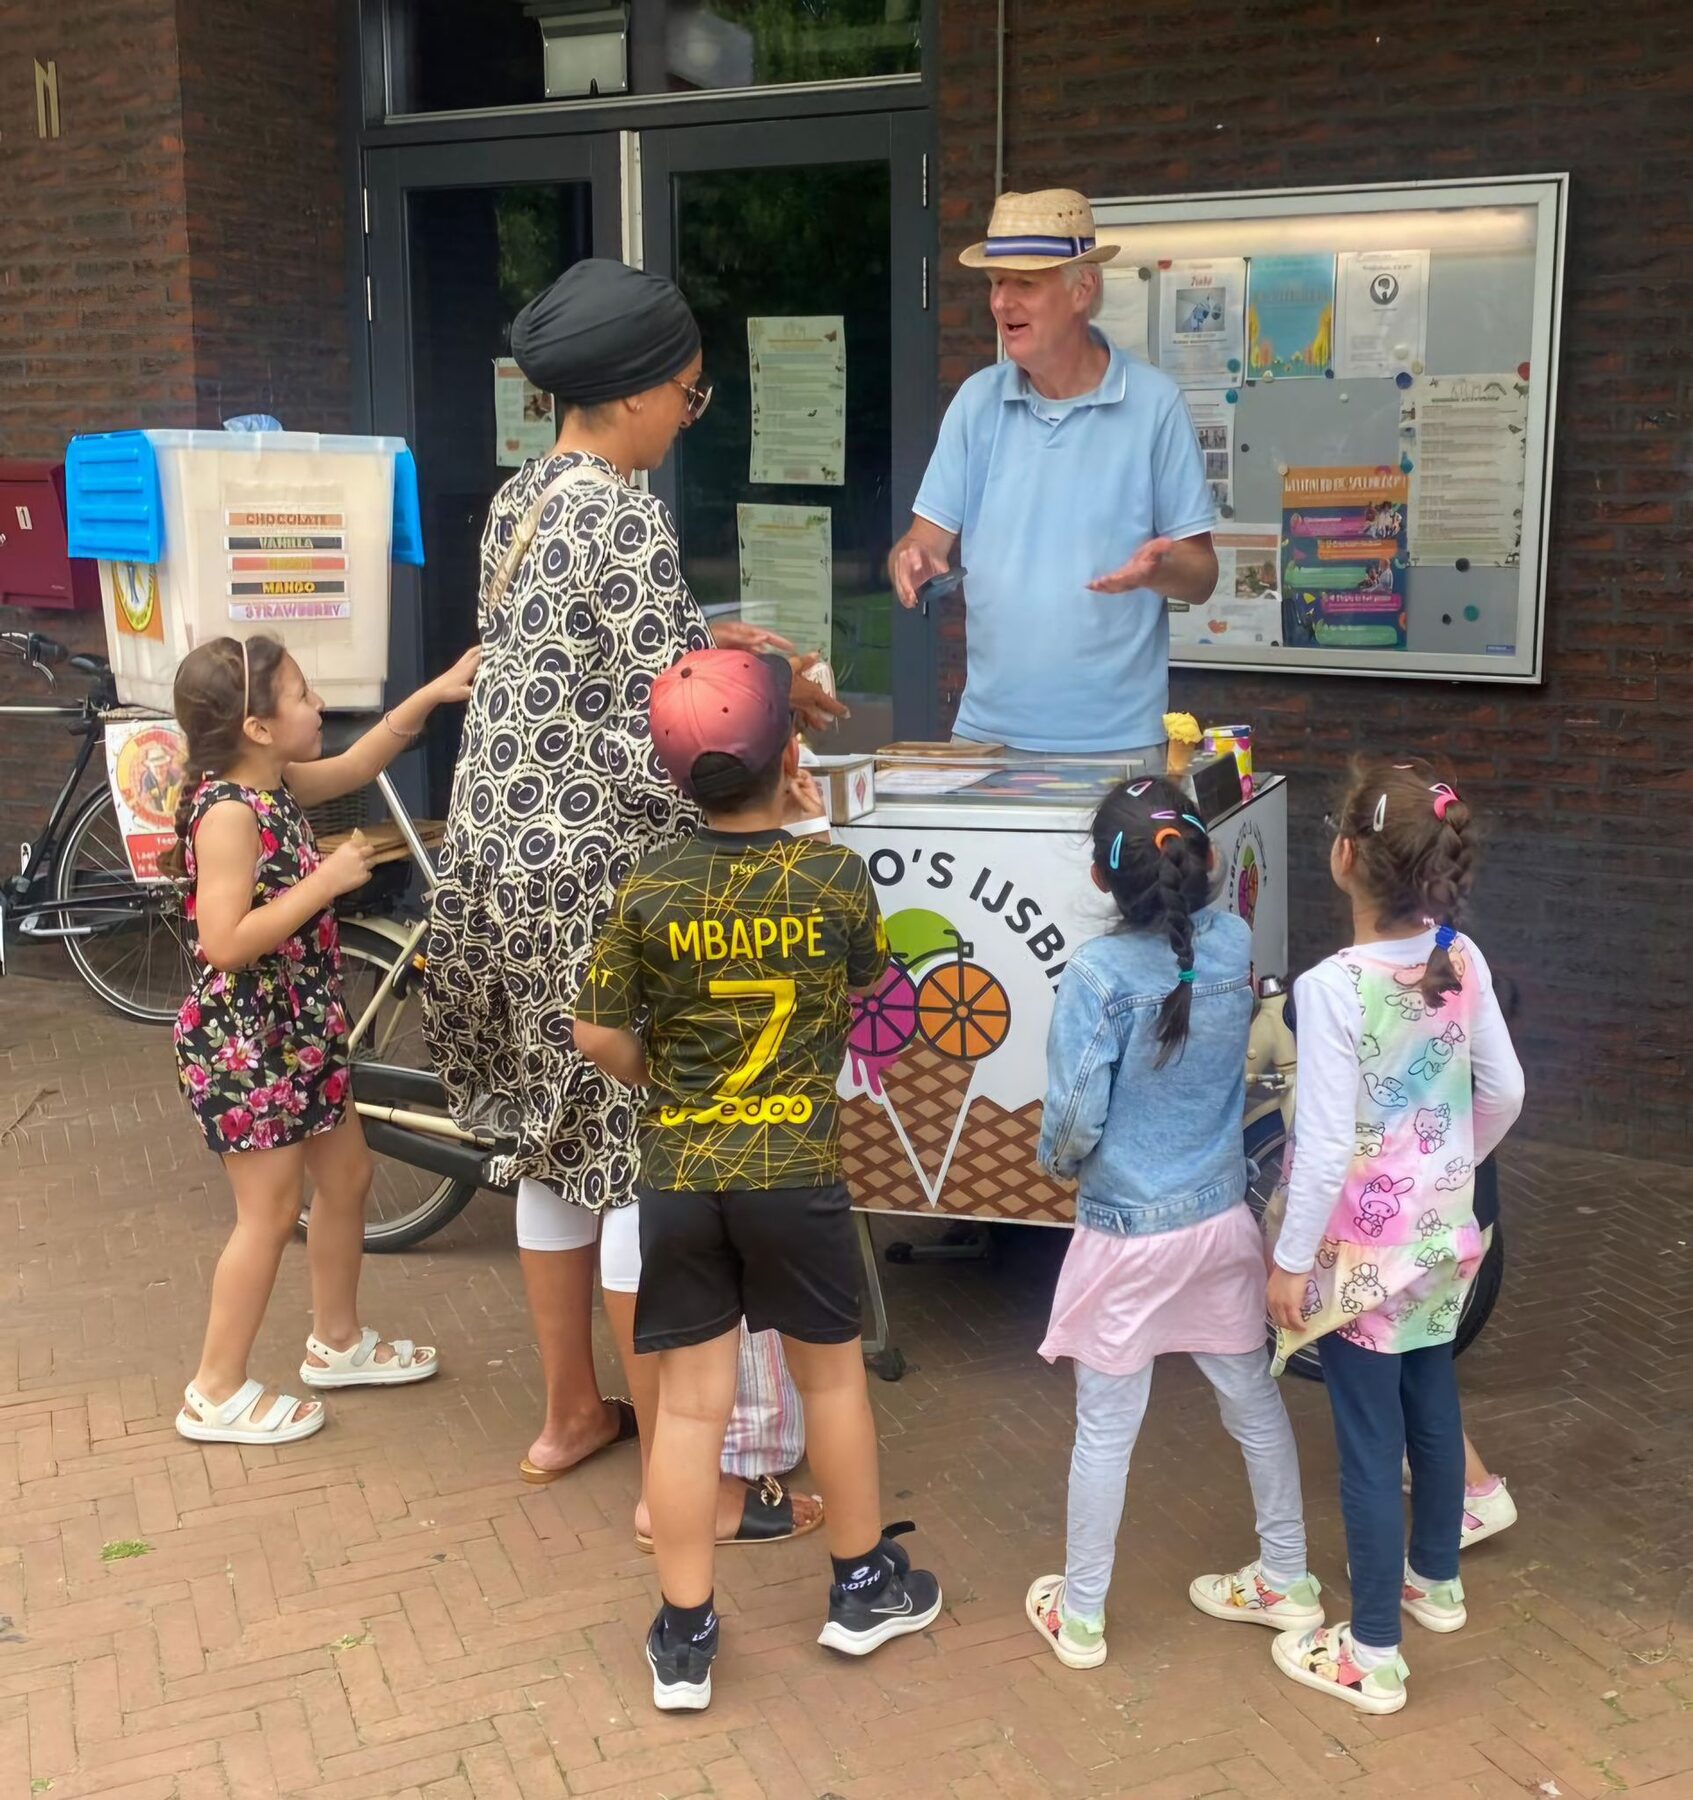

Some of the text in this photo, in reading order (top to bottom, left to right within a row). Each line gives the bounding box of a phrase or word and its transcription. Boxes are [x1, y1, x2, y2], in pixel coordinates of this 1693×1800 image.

[246, 513, 327, 526] CHOCOLATE
[669, 907, 826, 962] MBAPPÉ
[868, 848, 956, 890] O'S
[969, 866, 1068, 994] IJSB
[708, 978, 798, 1100] 7
